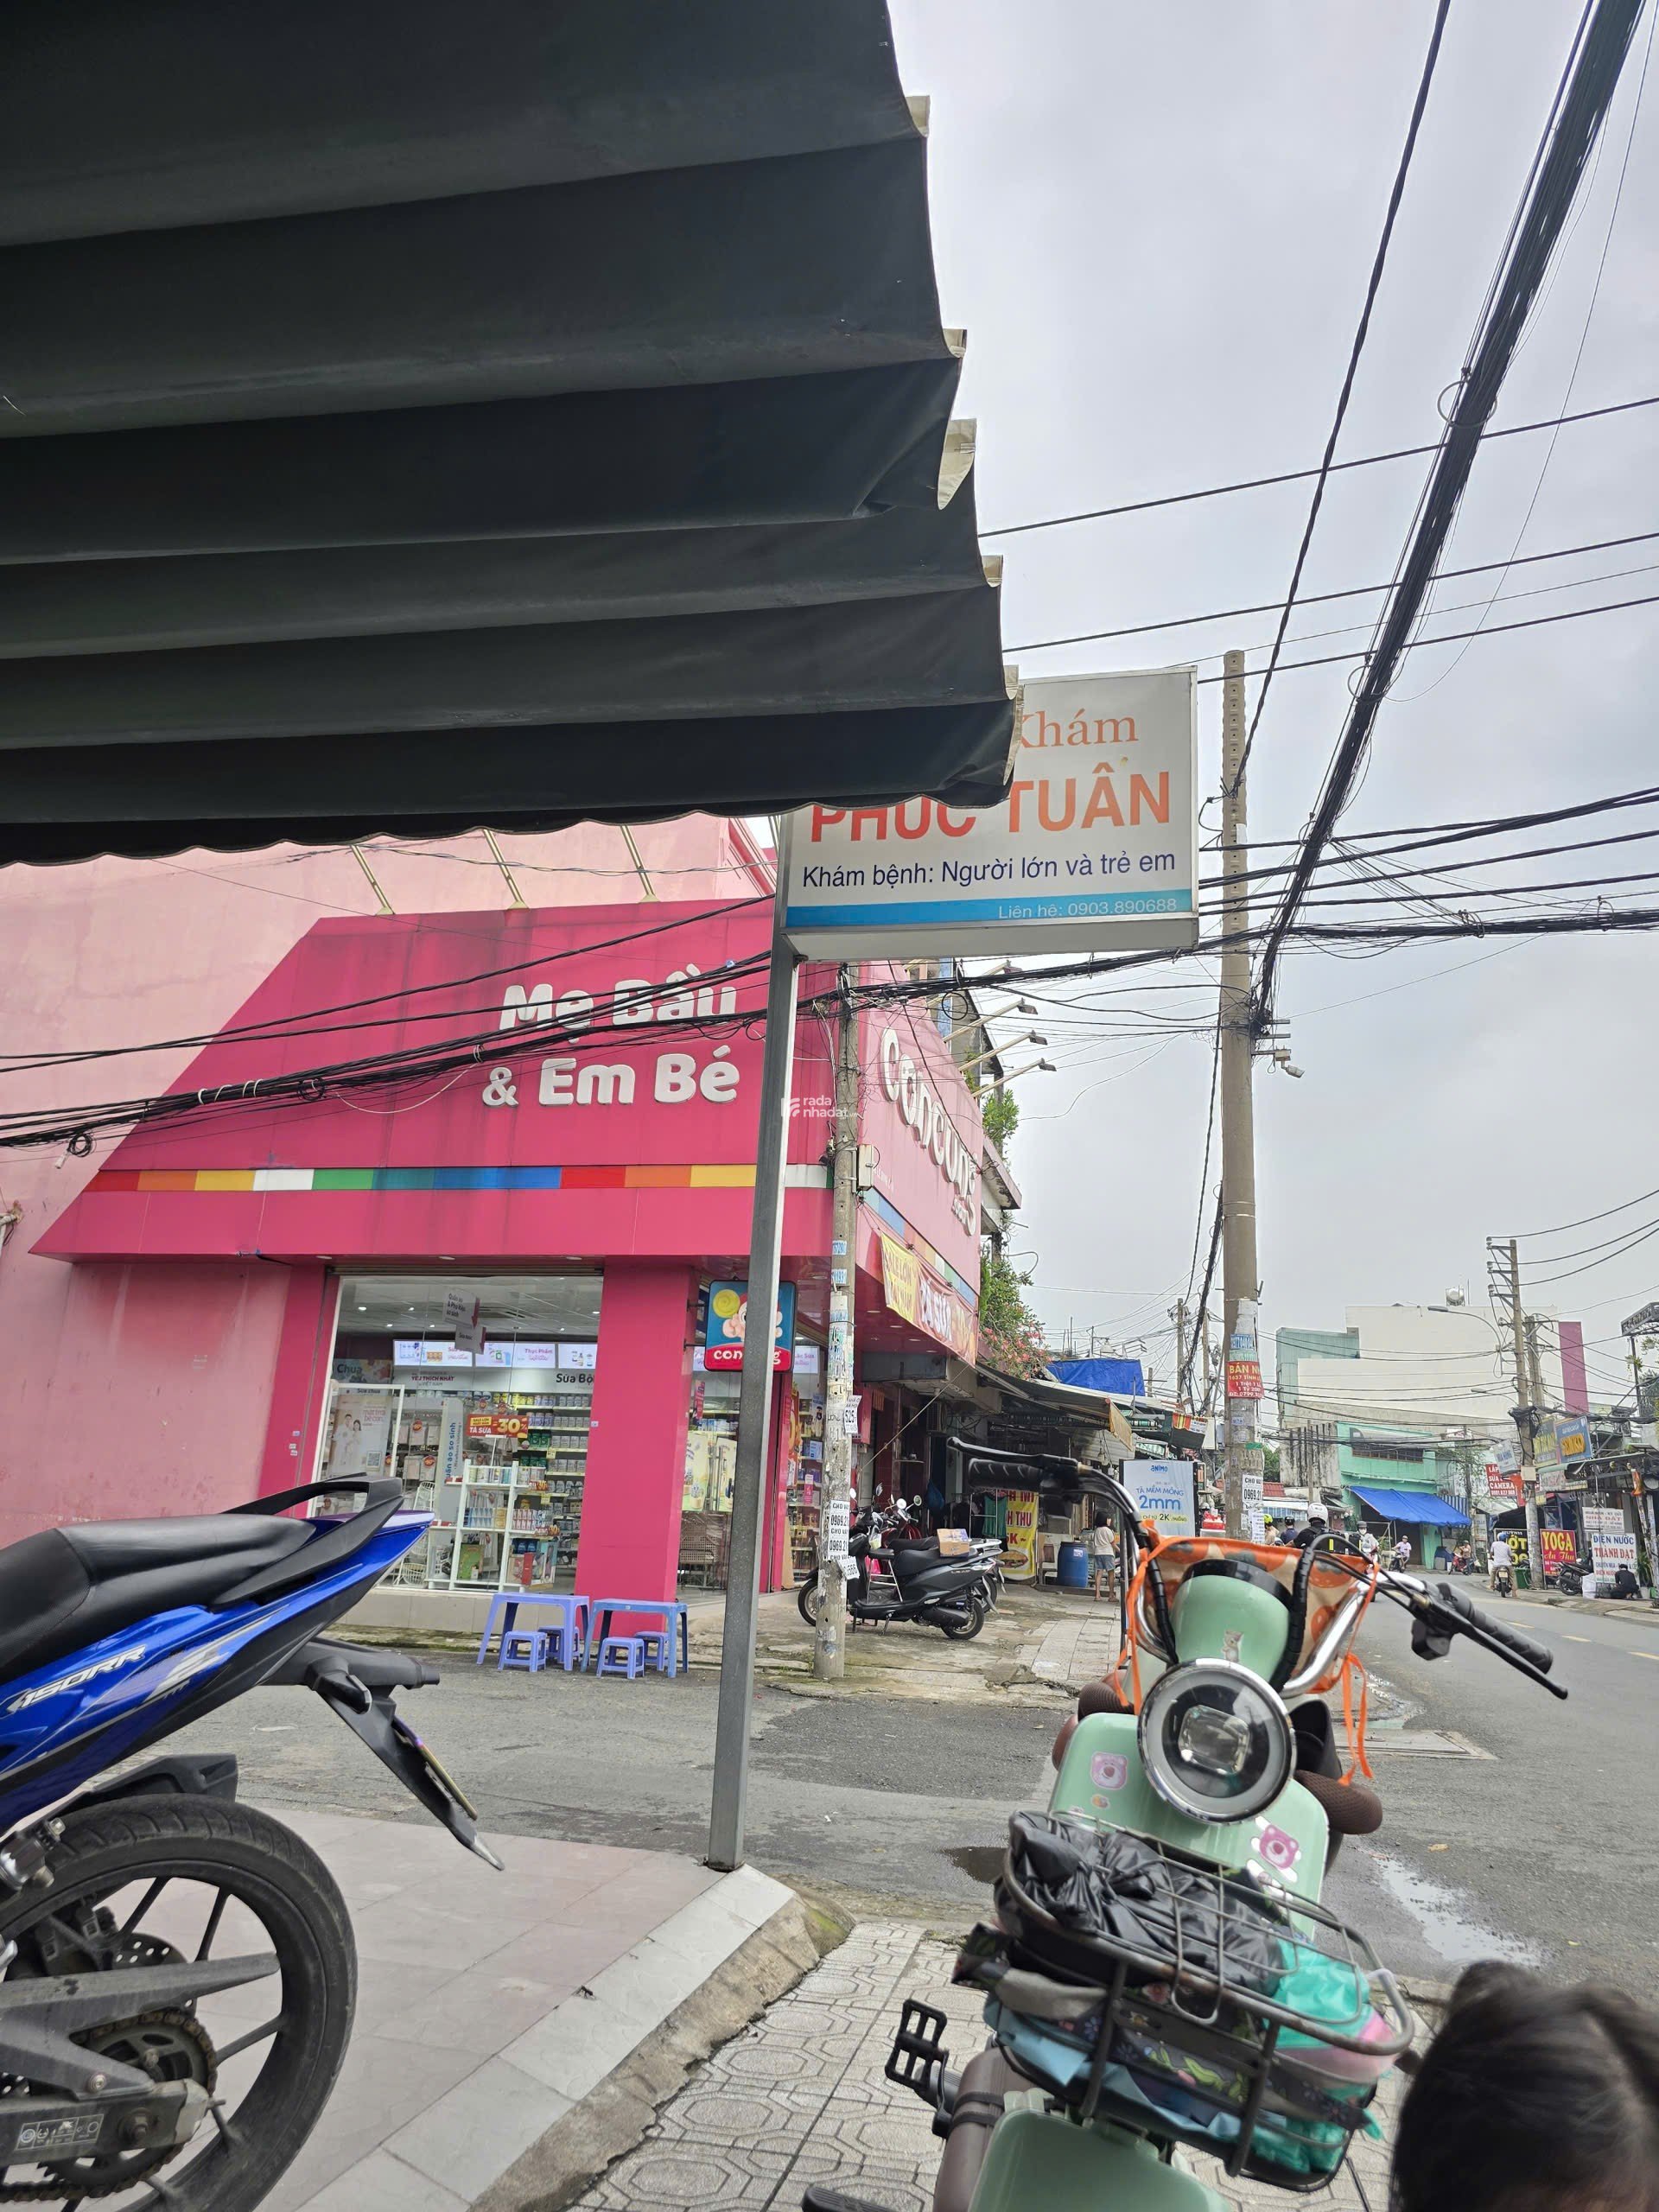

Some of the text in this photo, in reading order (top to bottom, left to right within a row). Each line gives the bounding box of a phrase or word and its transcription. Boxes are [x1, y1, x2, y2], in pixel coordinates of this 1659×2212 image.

[803, 850, 1175, 889] Khám bệnh: Người lớn và trẻ em
[999, 898, 1178, 920] Liên hệ: 0903.890688
[482, 1045, 741, 1108] & Em Bé
[713, 1350, 782, 1365] cong
[1229, 1362, 1249, 1374] BÁN
[578, 1373, 595, 1385] Bộ
[1139, 1495, 1181, 1510] 2mm
[1015, 1511, 1032, 1527] THU
[1541, 1531, 1573, 1552] YOGA
